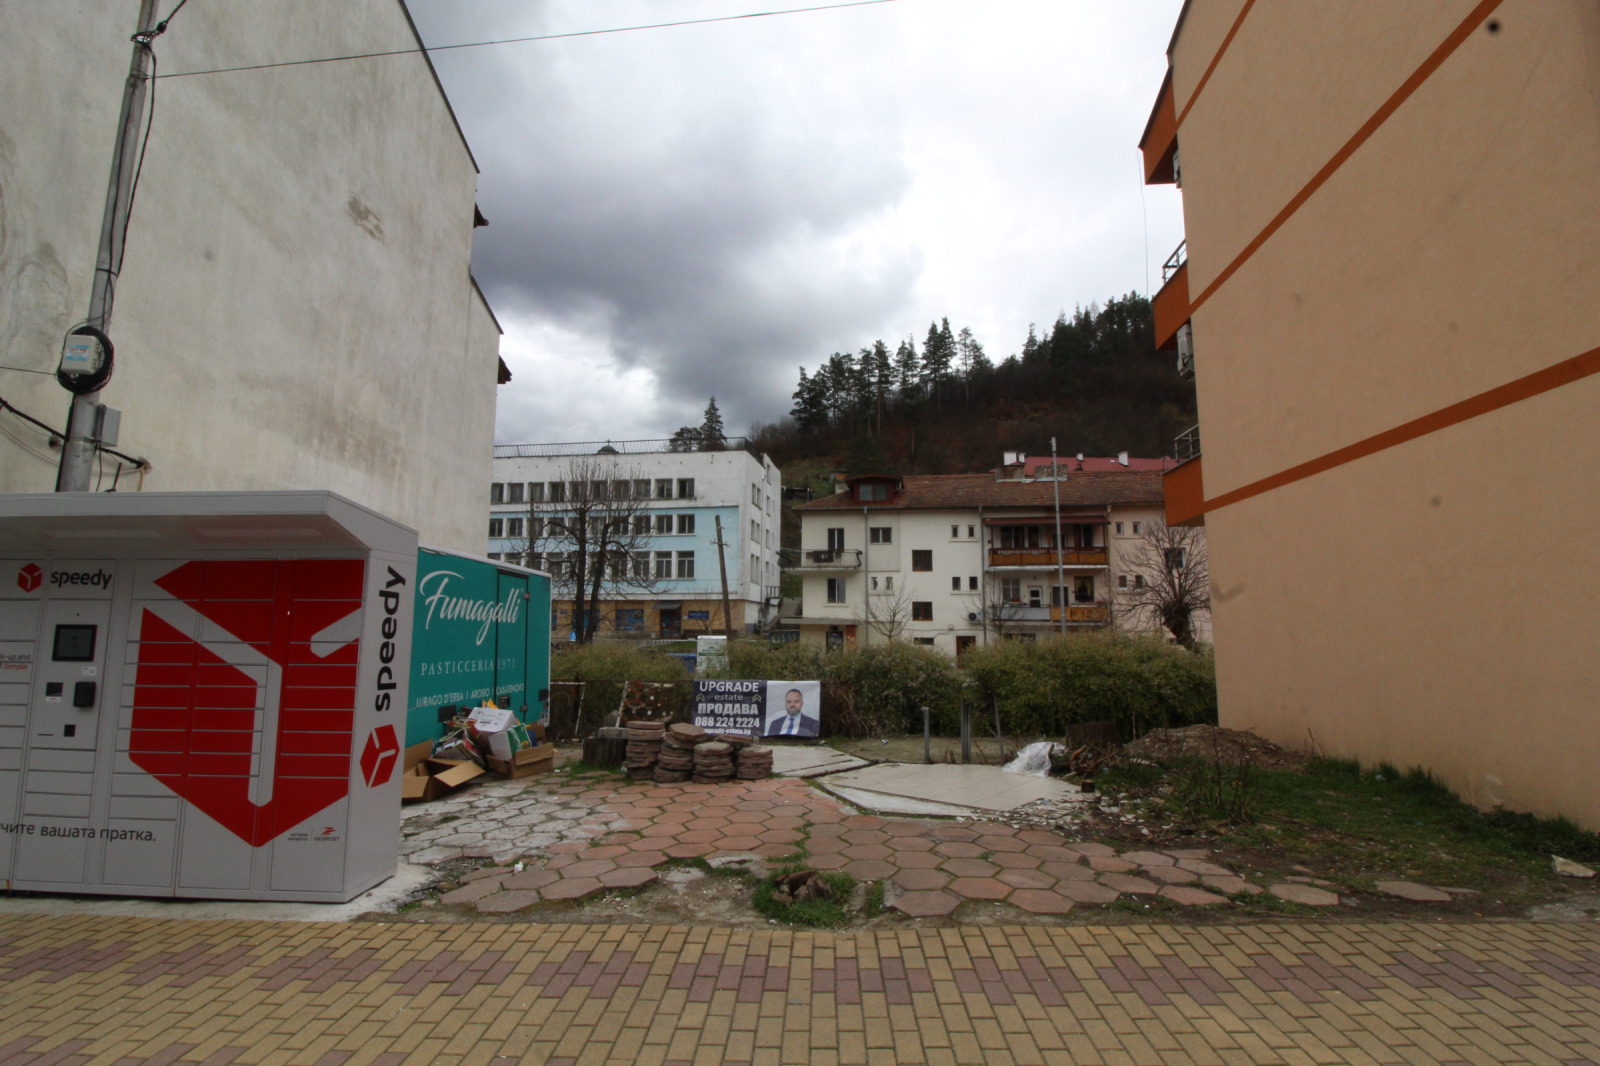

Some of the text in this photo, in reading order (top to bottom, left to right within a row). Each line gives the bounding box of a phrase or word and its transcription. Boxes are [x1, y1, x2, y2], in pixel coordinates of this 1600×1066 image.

[50, 569, 112, 590] speedy
[419, 570, 521, 645] Fumagalli
[375, 565, 406, 712] speedy
[421, 658, 516, 676] PASTICCERIA 1971
[699, 681, 759, 692] UPGRADE
[416, 694, 443, 708] LURAGO
[443, 691, 464, 703] D'ERBA
[470, 688, 490, 699] AROSIO
[697, 703, 759, 716] ПРОДАВА
[695, 717, 760, 728] 088 224 2224
[0, 822, 156, 842] чите вашата пратка.
